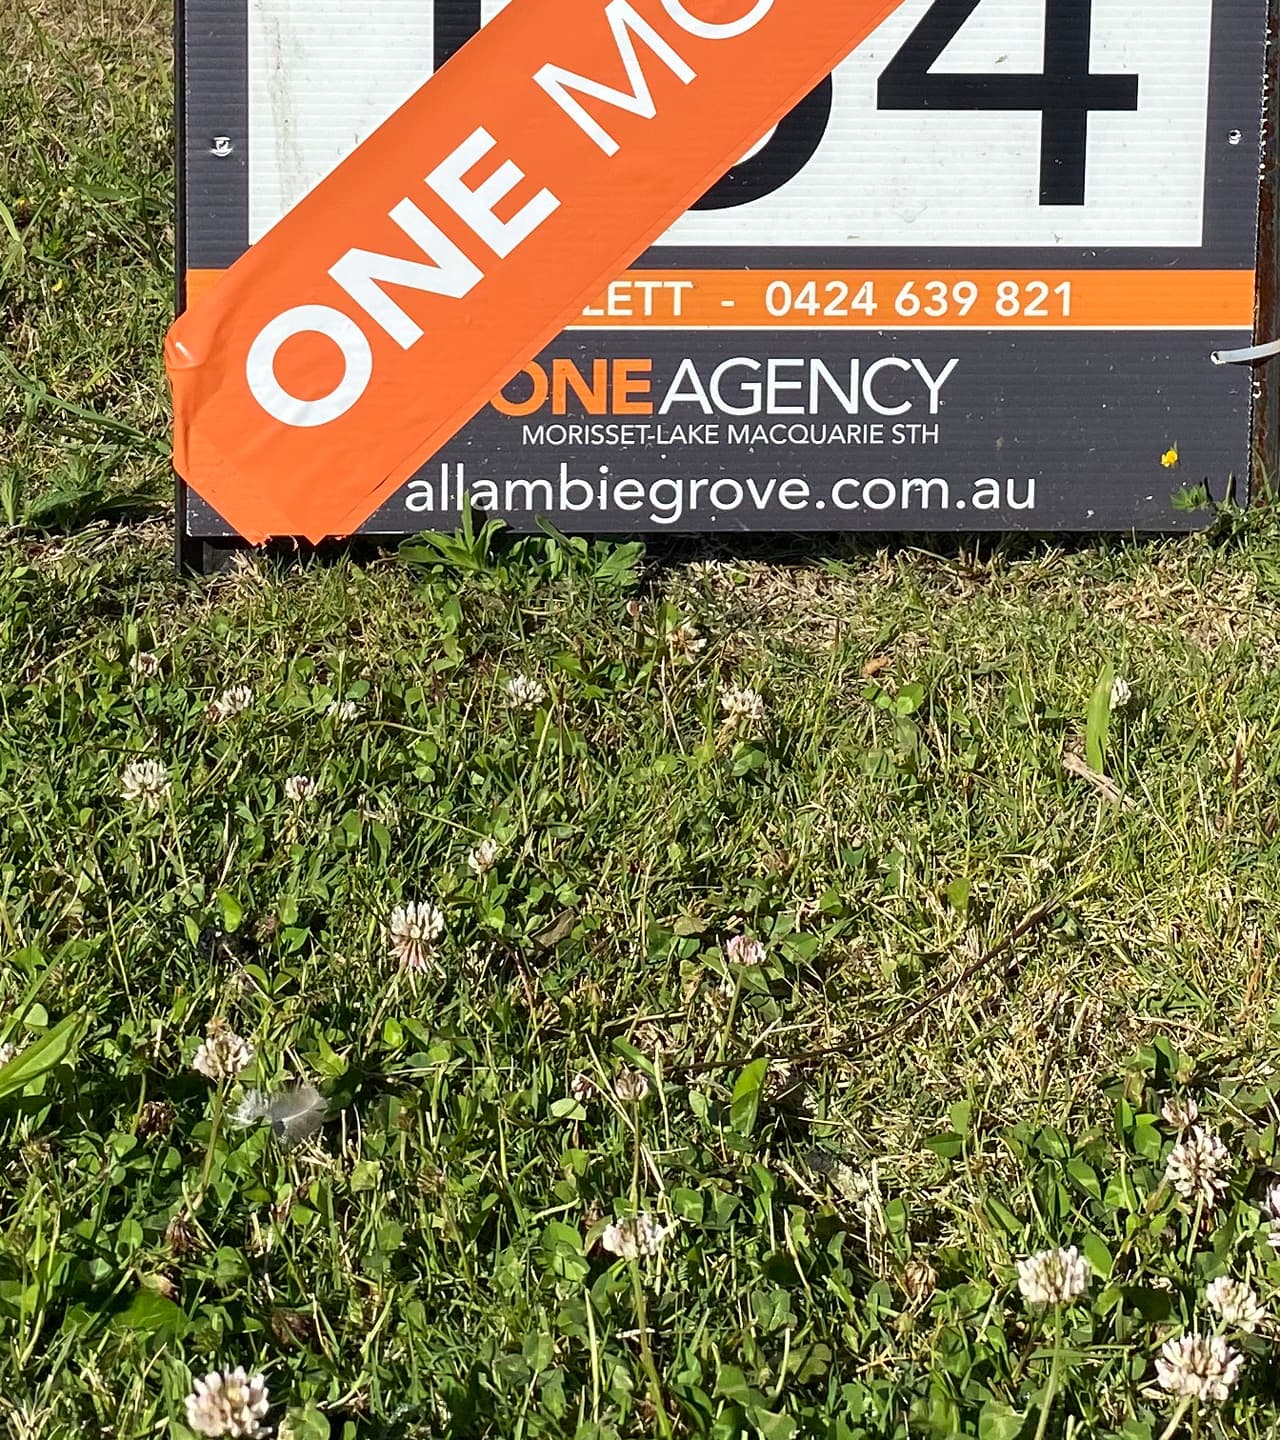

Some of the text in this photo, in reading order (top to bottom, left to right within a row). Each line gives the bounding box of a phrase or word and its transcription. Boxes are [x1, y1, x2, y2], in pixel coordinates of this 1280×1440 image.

[246, 126, 561, 427] ONE
[765, 280, 878, 317] 0424
[894, 280, 979, 317] 639
[994, 280, 1071, 317] 821
[727, 423, 884, 445] MACQUARIE
[891, 423, 939, 445] STH
[405, 462, 1035, 525] allambiegrove.com.au
